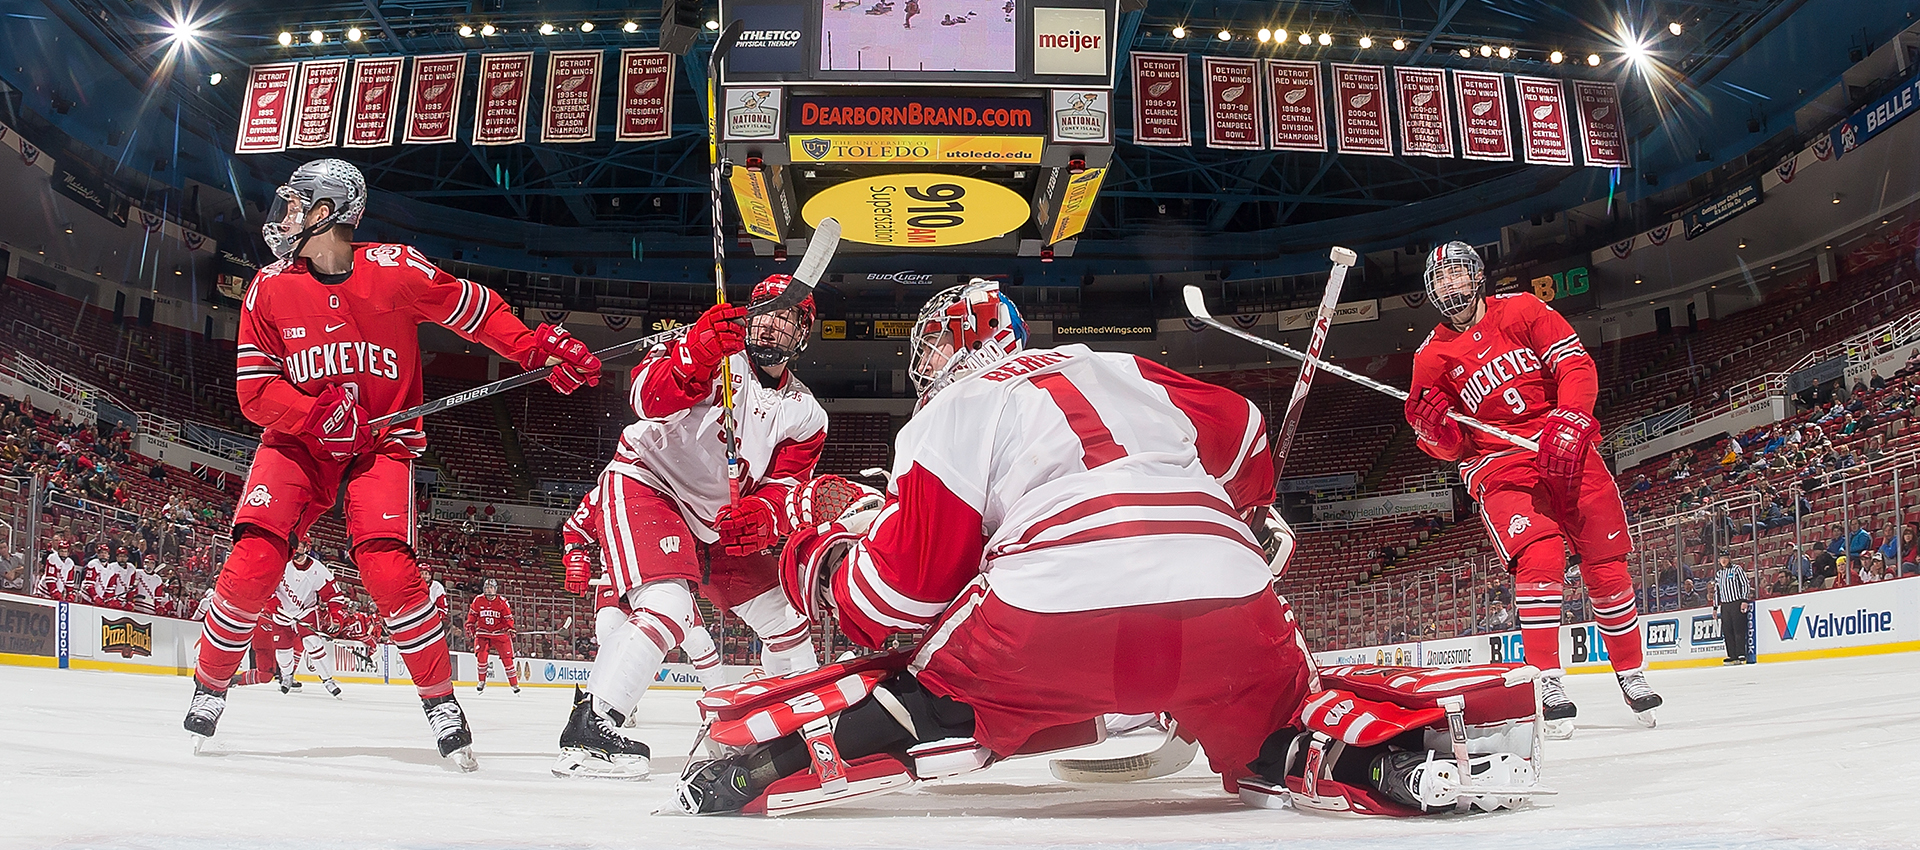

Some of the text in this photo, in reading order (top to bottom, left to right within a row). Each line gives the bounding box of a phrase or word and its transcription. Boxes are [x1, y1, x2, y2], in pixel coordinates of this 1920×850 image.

[1039, 30, 1101, 52] meijer
[633, 58, 664, 66] DETROIT
[1344, 74, 1374, 82] DETROIT
[1527, 86, 1553, 94] DETROIT
[1217, 112, 1252, 120] CLARENCE
[1867, 87, 1912, 132] BELLE
[733, 115, 771, 124] NATIONAL
[1061, 116, 1100, 126] NATIONAL
[1217, 121, 1252, 129] CAMPBELL
[1345, 137, 1383, 145] CHAMPIONS
[1533, 130, 1560, 138] CENTRAL
[806, 143, 825, 152] UT
[833, 146, 929, 158] TOLEDO
[947, 151, 1032, 159] utoledo.edu
[866, 186, 898, 243] Superstation
[905, 184, 966, 243] 910 AM
[1058, 326, 1151, 335] DetroitRedWings.com
[286, 342, 398, 384] BUCKEYES
[980, 352, 1074, 382] BERRY
[1460, 348, 1542, 414] BUCKEYES
[1503, 387, 1527, 414] 9
[1027, 371, 1129, 470] 1
[1279, 420, 1296, 458] PREMIER
[60, 604, 68, 656] Reebok
[1693, 619, 1721, 639] BTN
[1805, 609, 1892, 638] Valvoline
[103, 623, 150, 650] Pizza Ranch
[1649, 624, 1675, 643] BTN
[1427, 649, 1471, 665] BRIDGESTONE
